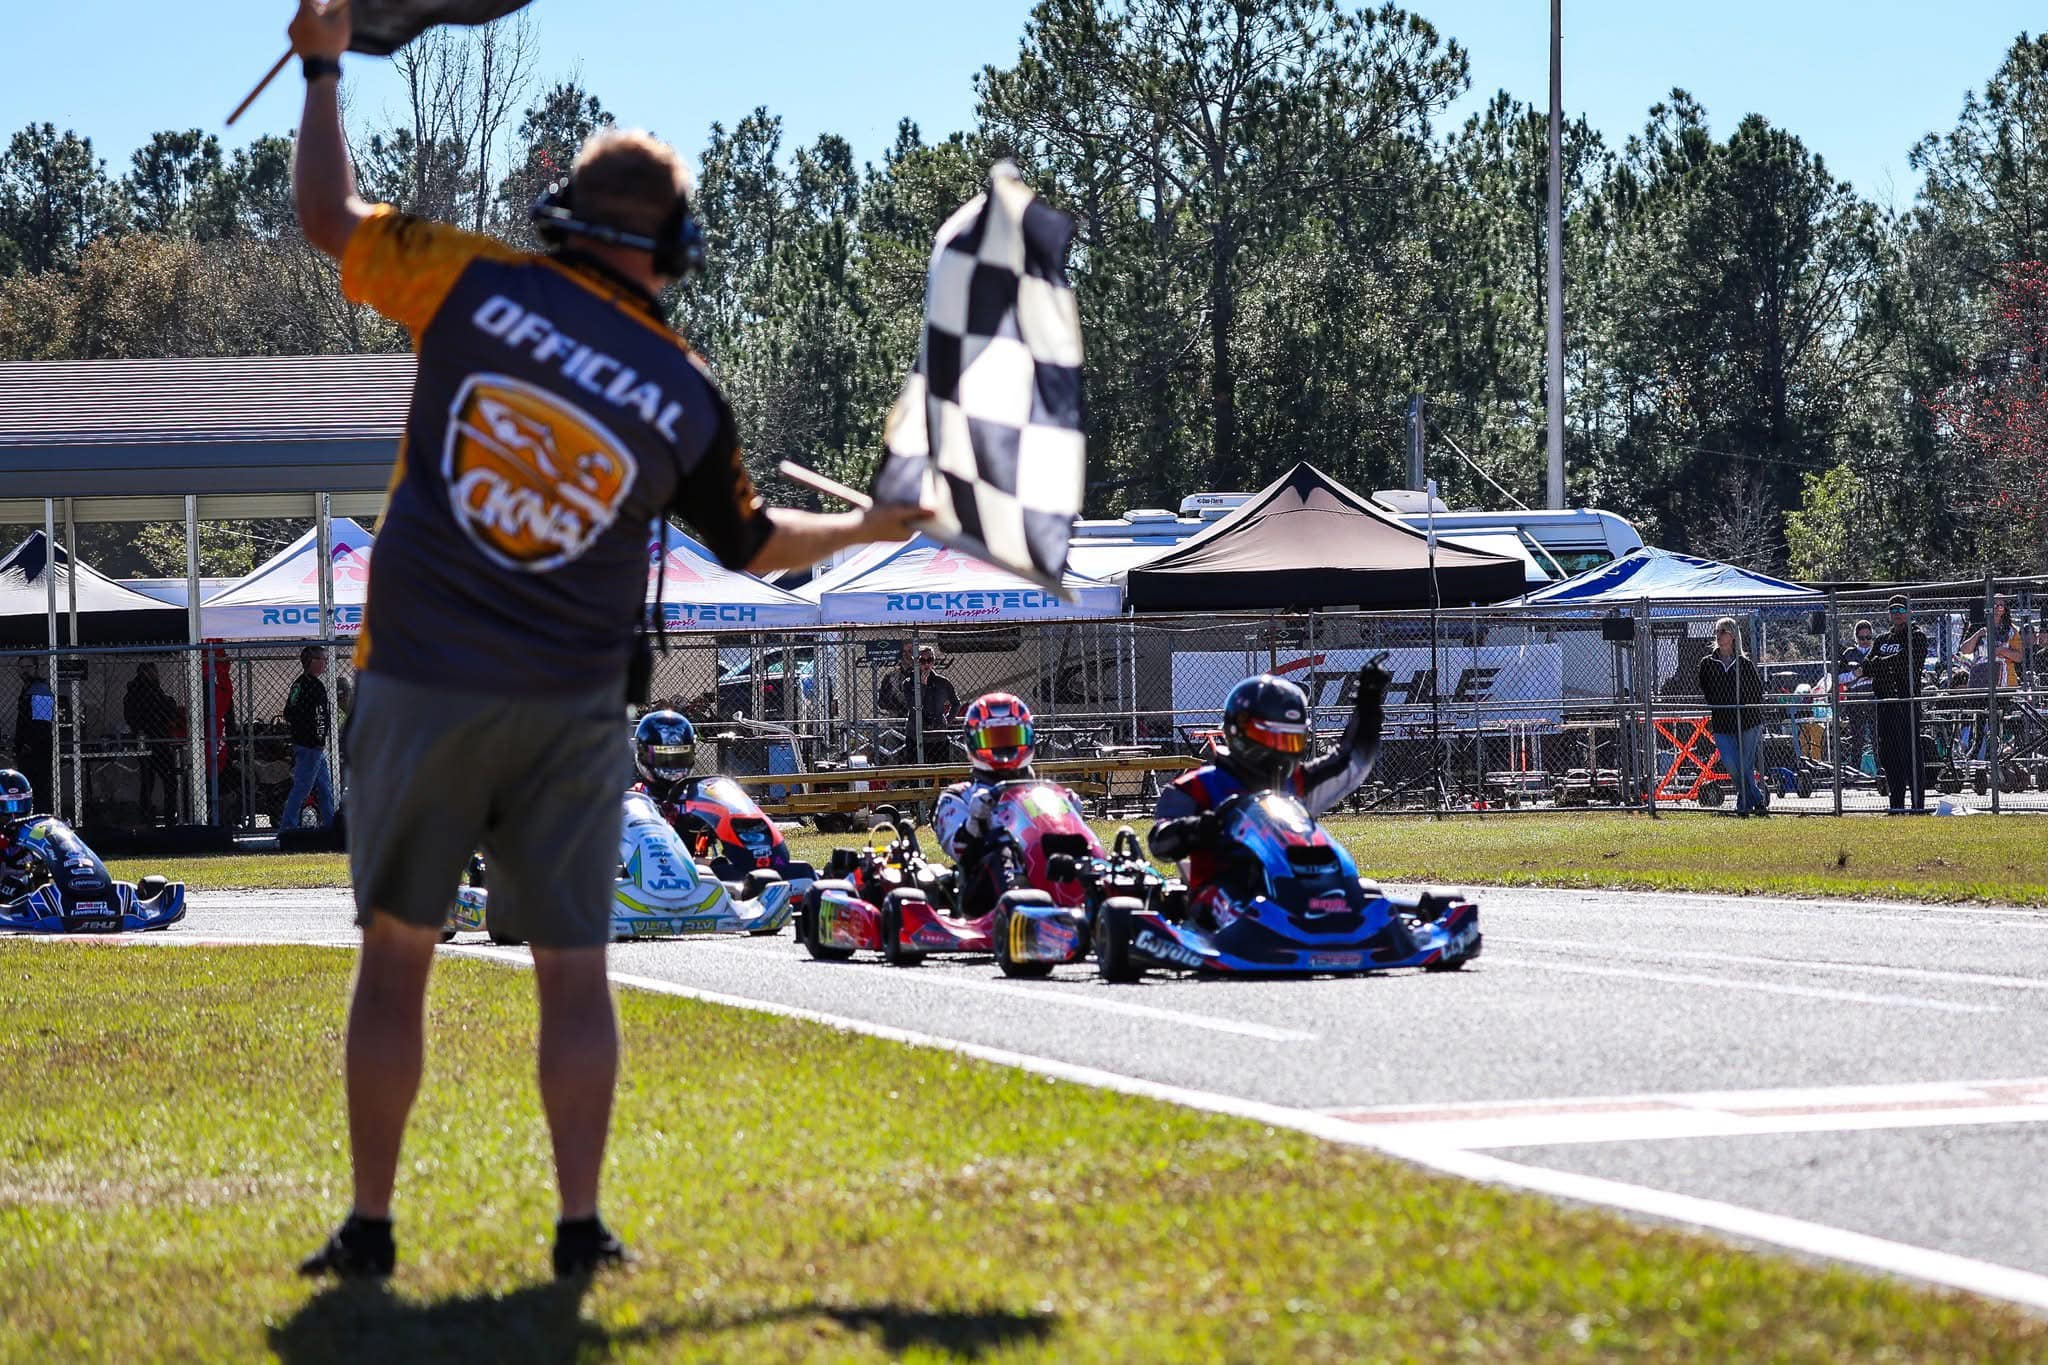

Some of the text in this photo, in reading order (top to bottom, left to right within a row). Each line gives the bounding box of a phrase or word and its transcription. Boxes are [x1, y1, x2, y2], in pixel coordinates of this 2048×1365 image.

[472, 295, 685, 444] OFFICIAL
[886, 591, 1060, 612] ROCKETECH
[262, 607, 362, 625] ROCKE
[663, 603, 756, 622] ETECH
[944, 606, 1000, 618] Motorsports
